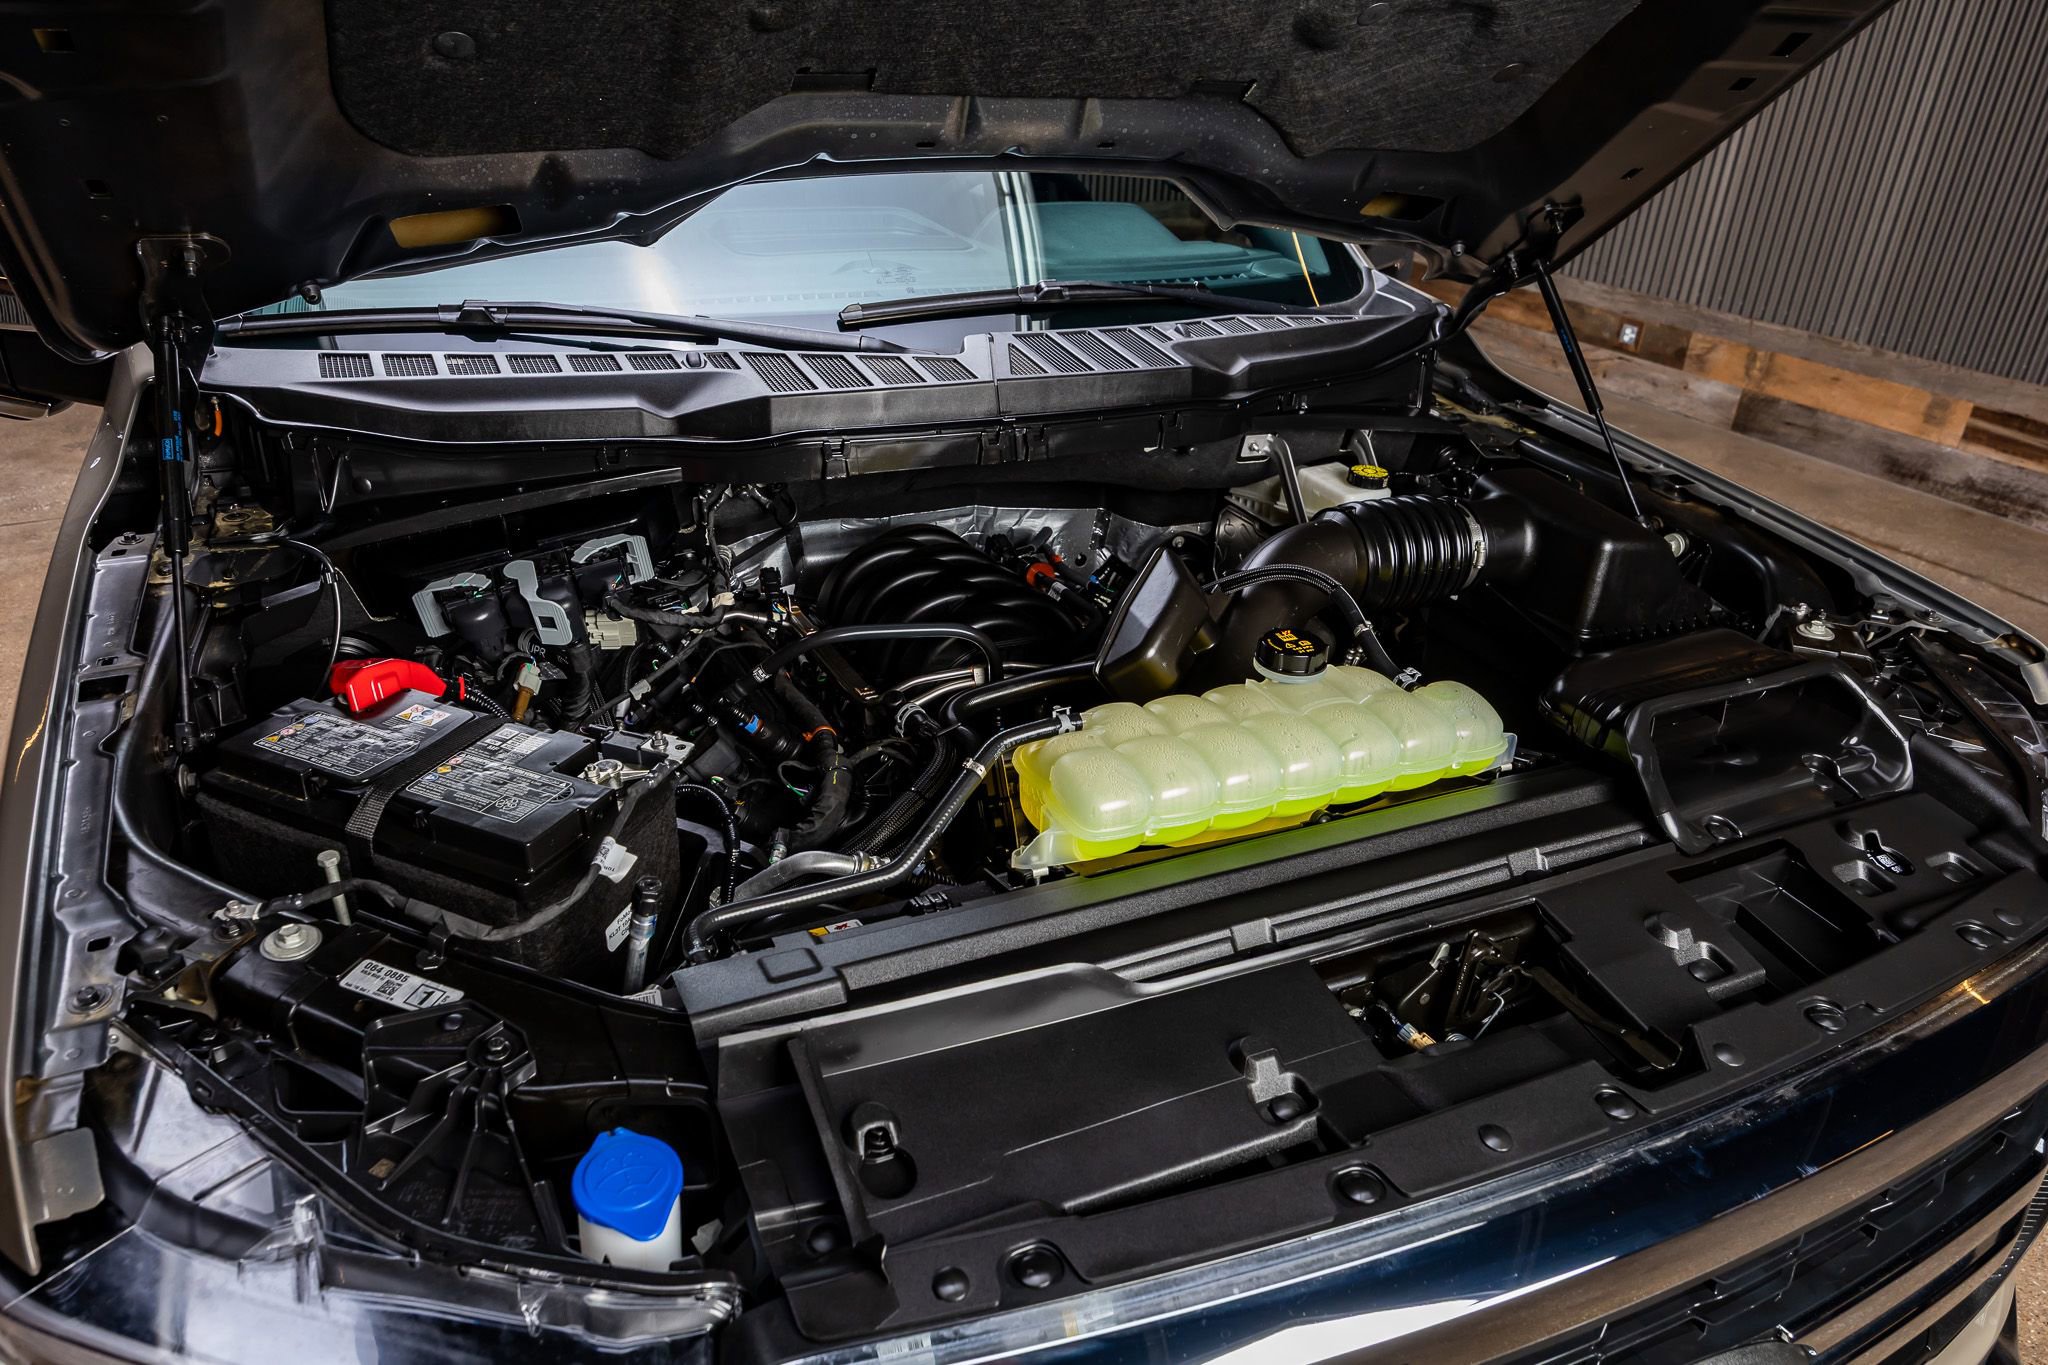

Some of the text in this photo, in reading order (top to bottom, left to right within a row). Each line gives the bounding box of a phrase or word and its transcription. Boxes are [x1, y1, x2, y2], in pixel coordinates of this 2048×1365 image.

[364, 962, 384, 973] 064
[384, 970, 410, 983] 0885
[417, 990, 436, 1006] 1
